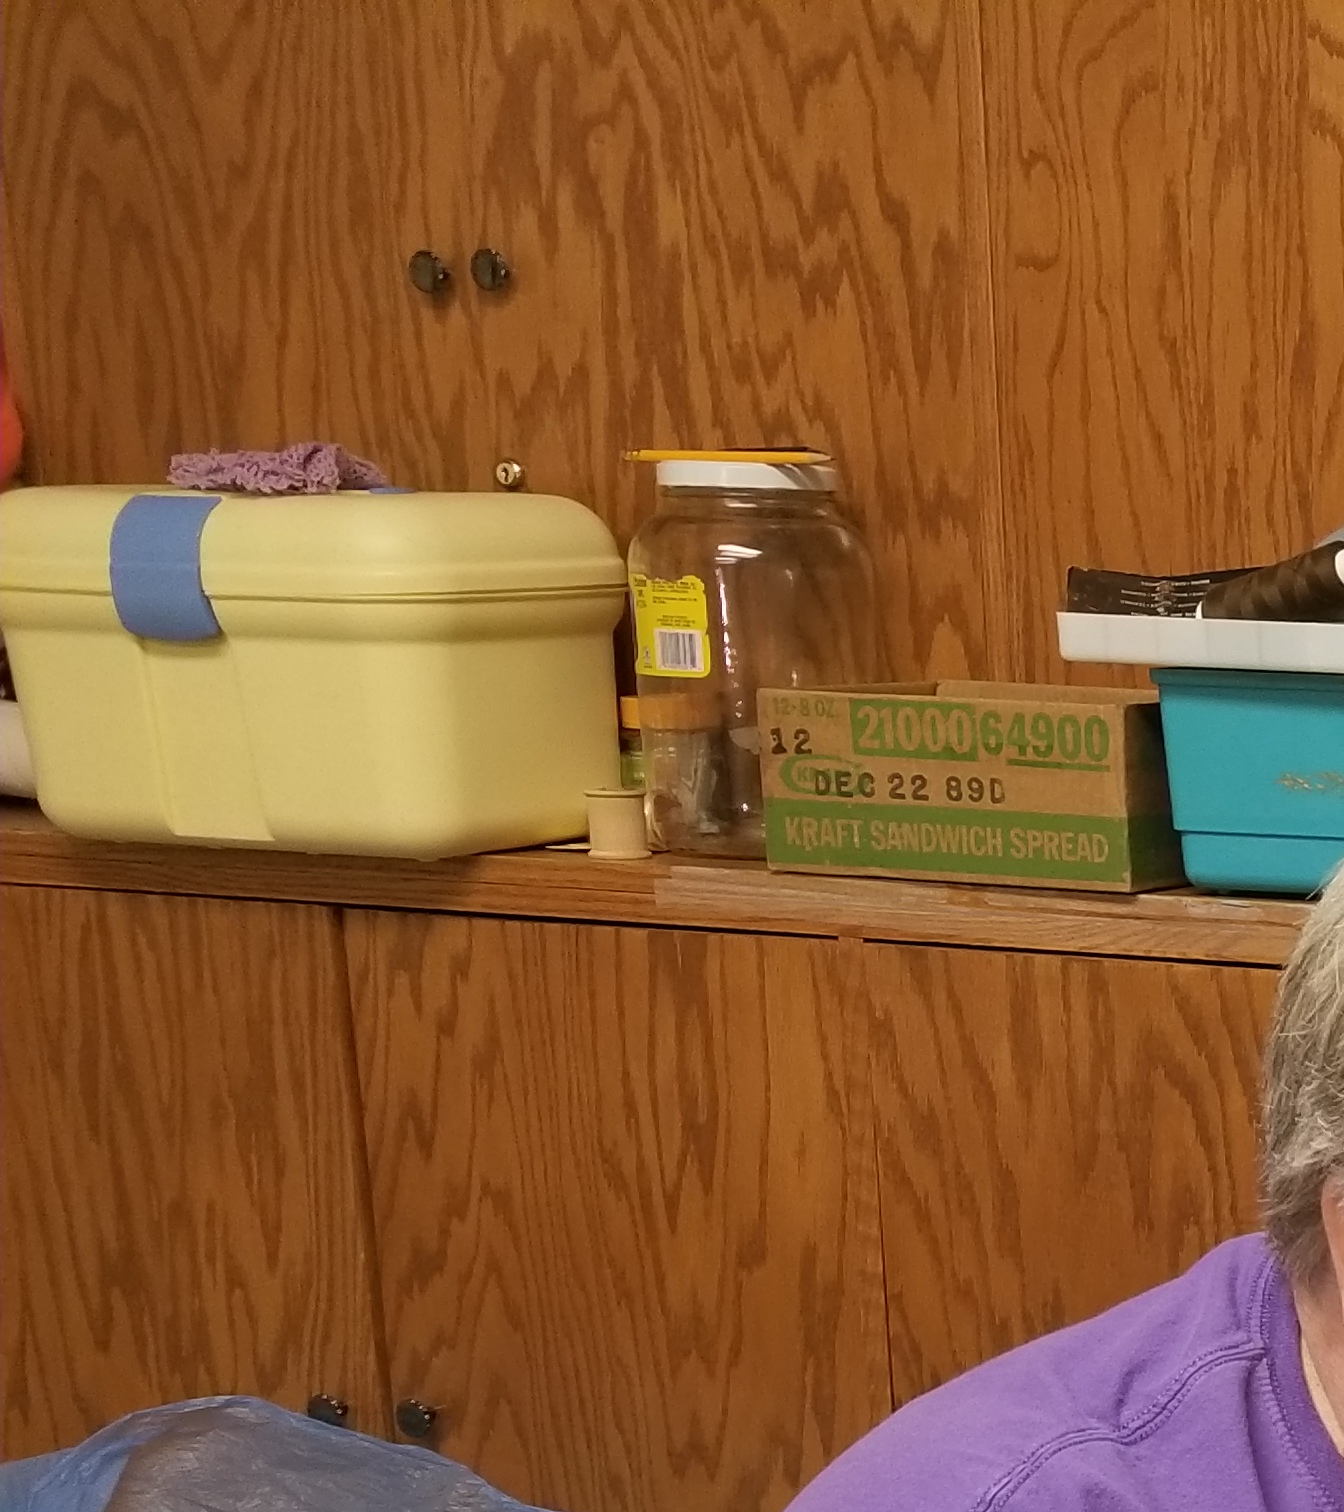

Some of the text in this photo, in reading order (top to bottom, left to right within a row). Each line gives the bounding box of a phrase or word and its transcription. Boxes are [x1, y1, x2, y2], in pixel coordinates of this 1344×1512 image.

[814, 769, 876, 798] DEC
[887, 772, 930, 801] 22
[785, 816, 1109, 863] KRAFT SANDWICH SPREAD
